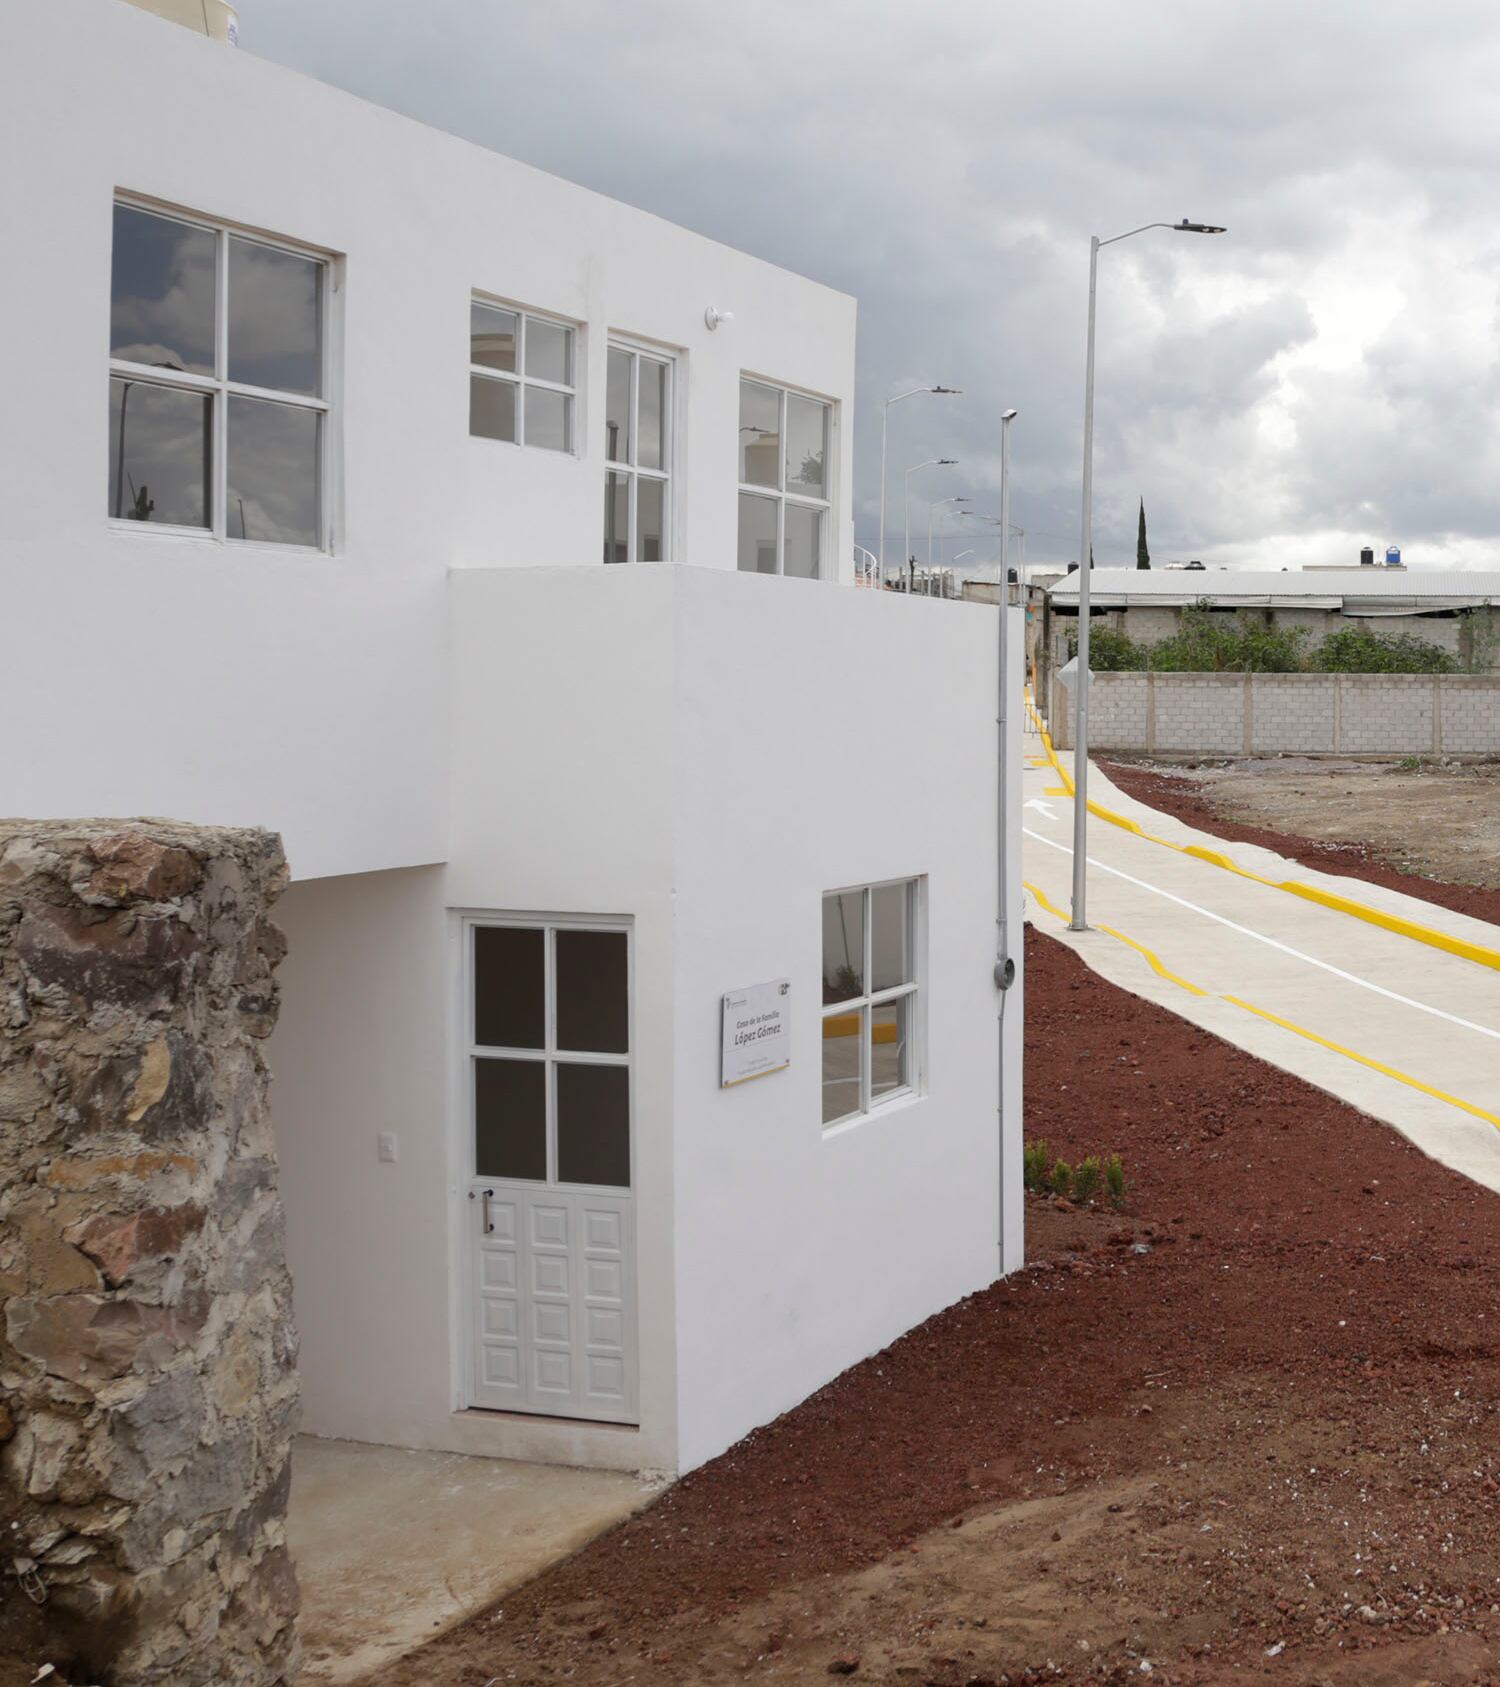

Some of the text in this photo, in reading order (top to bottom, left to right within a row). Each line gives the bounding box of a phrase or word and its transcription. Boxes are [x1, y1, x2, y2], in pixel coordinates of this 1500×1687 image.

[737, 1020, 749, 1029] Casa
[750, 1016, 756, 1025] de
[735, 1024, 781, 1046] López Gómez
